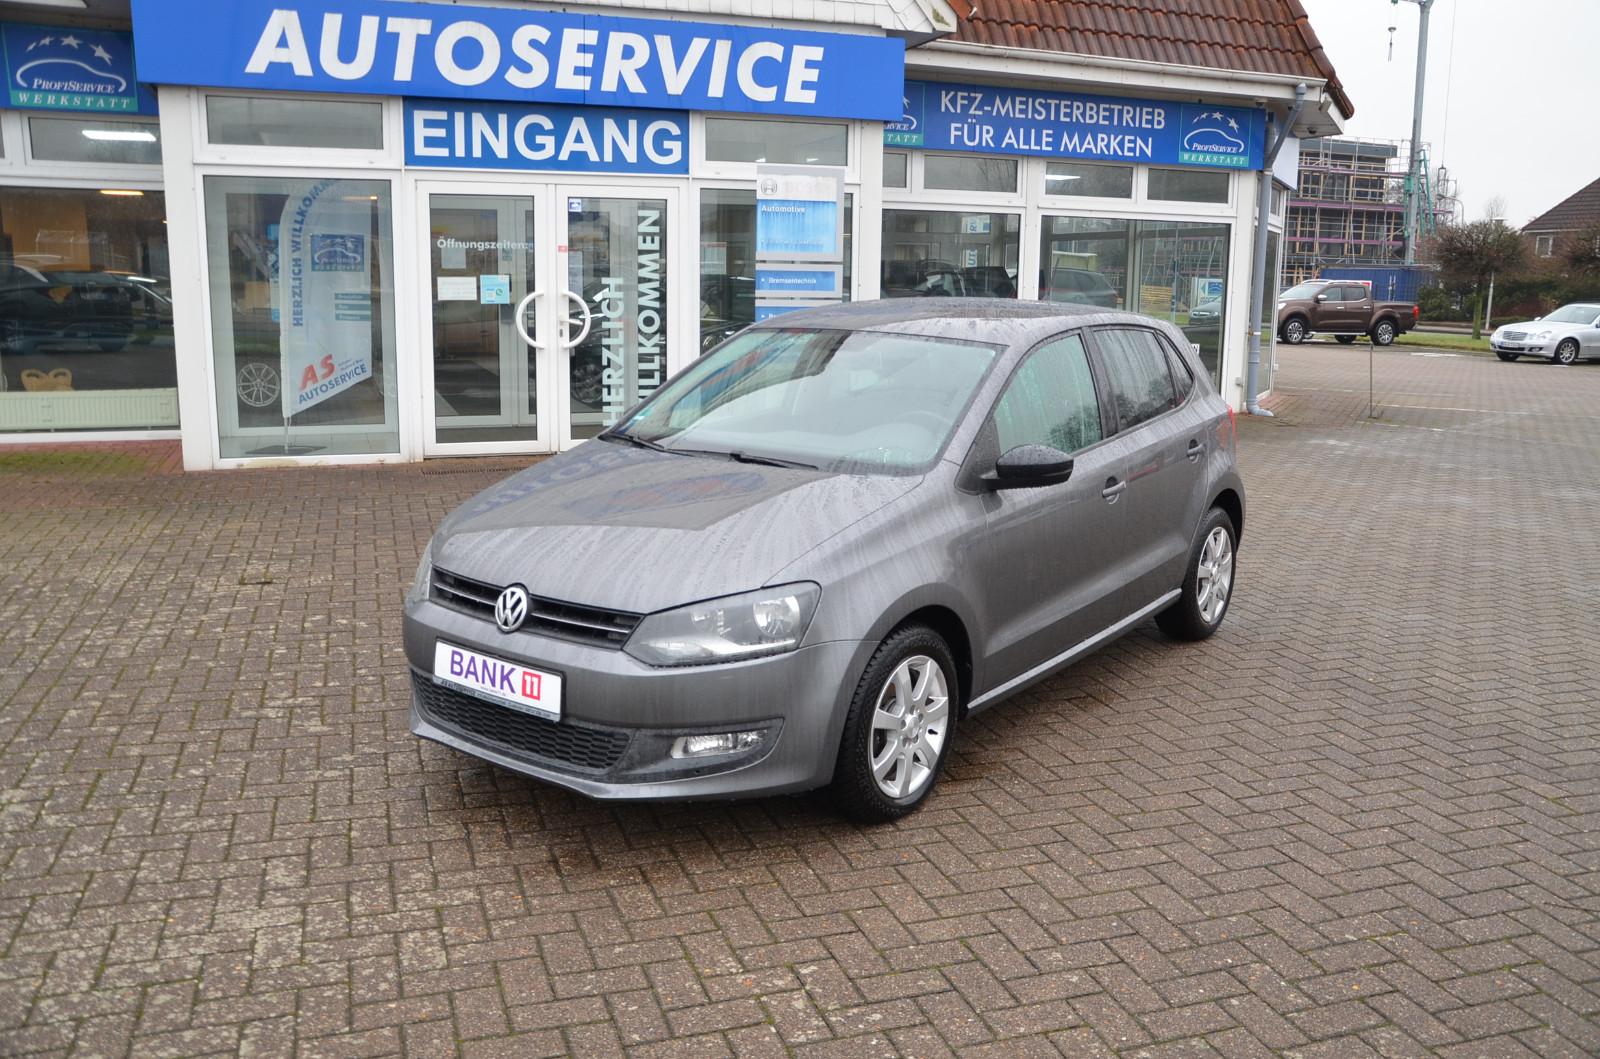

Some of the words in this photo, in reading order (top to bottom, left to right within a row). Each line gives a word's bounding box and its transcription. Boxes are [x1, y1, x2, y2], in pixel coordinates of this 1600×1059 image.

[244, 9, 825, 104] AUTOSERVICE
[19, 93, 130, 109] WERKSTATT
[940, 90, 1165, 129] KFZ-MEISTERBETRIEB
[411, 109, 682, 165] EINGANG
[950, 118, 994, 148] FÜR
[1001, 127, 1053, 151] ALLE
[1060, 130, 1152, 158] MARKEN
[1183, 153, 1246, 165] WERKSTATT
[761, 204, 806, 213] Automotive
[292, 258, 303, 327] HERZLICH
[601, 277, 625, 427] HERZLICH
[638, 209, 661, 404] ILLKOMMEN
[298, 363, 367, 405] AUTOSERVICE
[299, 353, 336, 391] AS
[450, 649, 516, 694] BANK
[524, 672, 539, 698] 11
